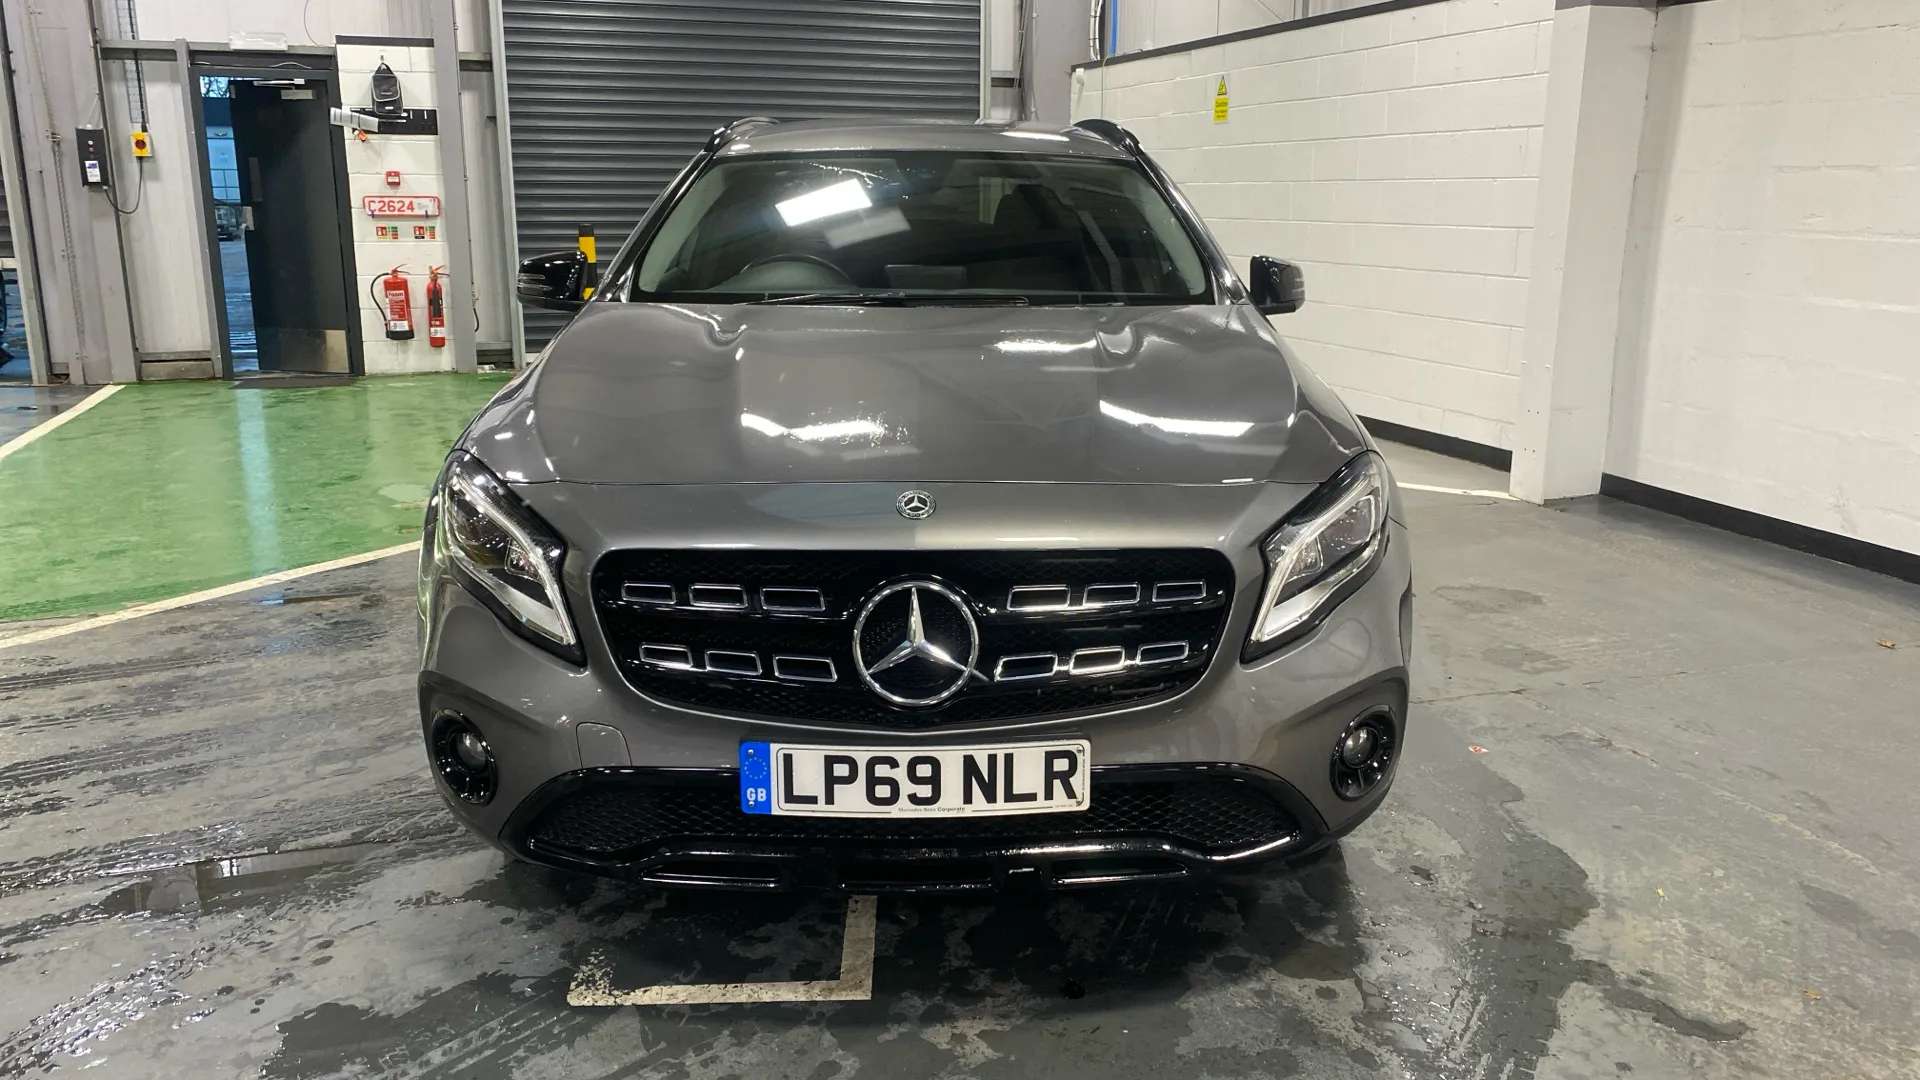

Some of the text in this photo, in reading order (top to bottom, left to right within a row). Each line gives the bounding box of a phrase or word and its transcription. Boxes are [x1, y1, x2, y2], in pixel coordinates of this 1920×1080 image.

[746, 788, 766, 802] GB
[783, 753, 941, 806] LP69
[963, 750, 1077, 805] NLR
